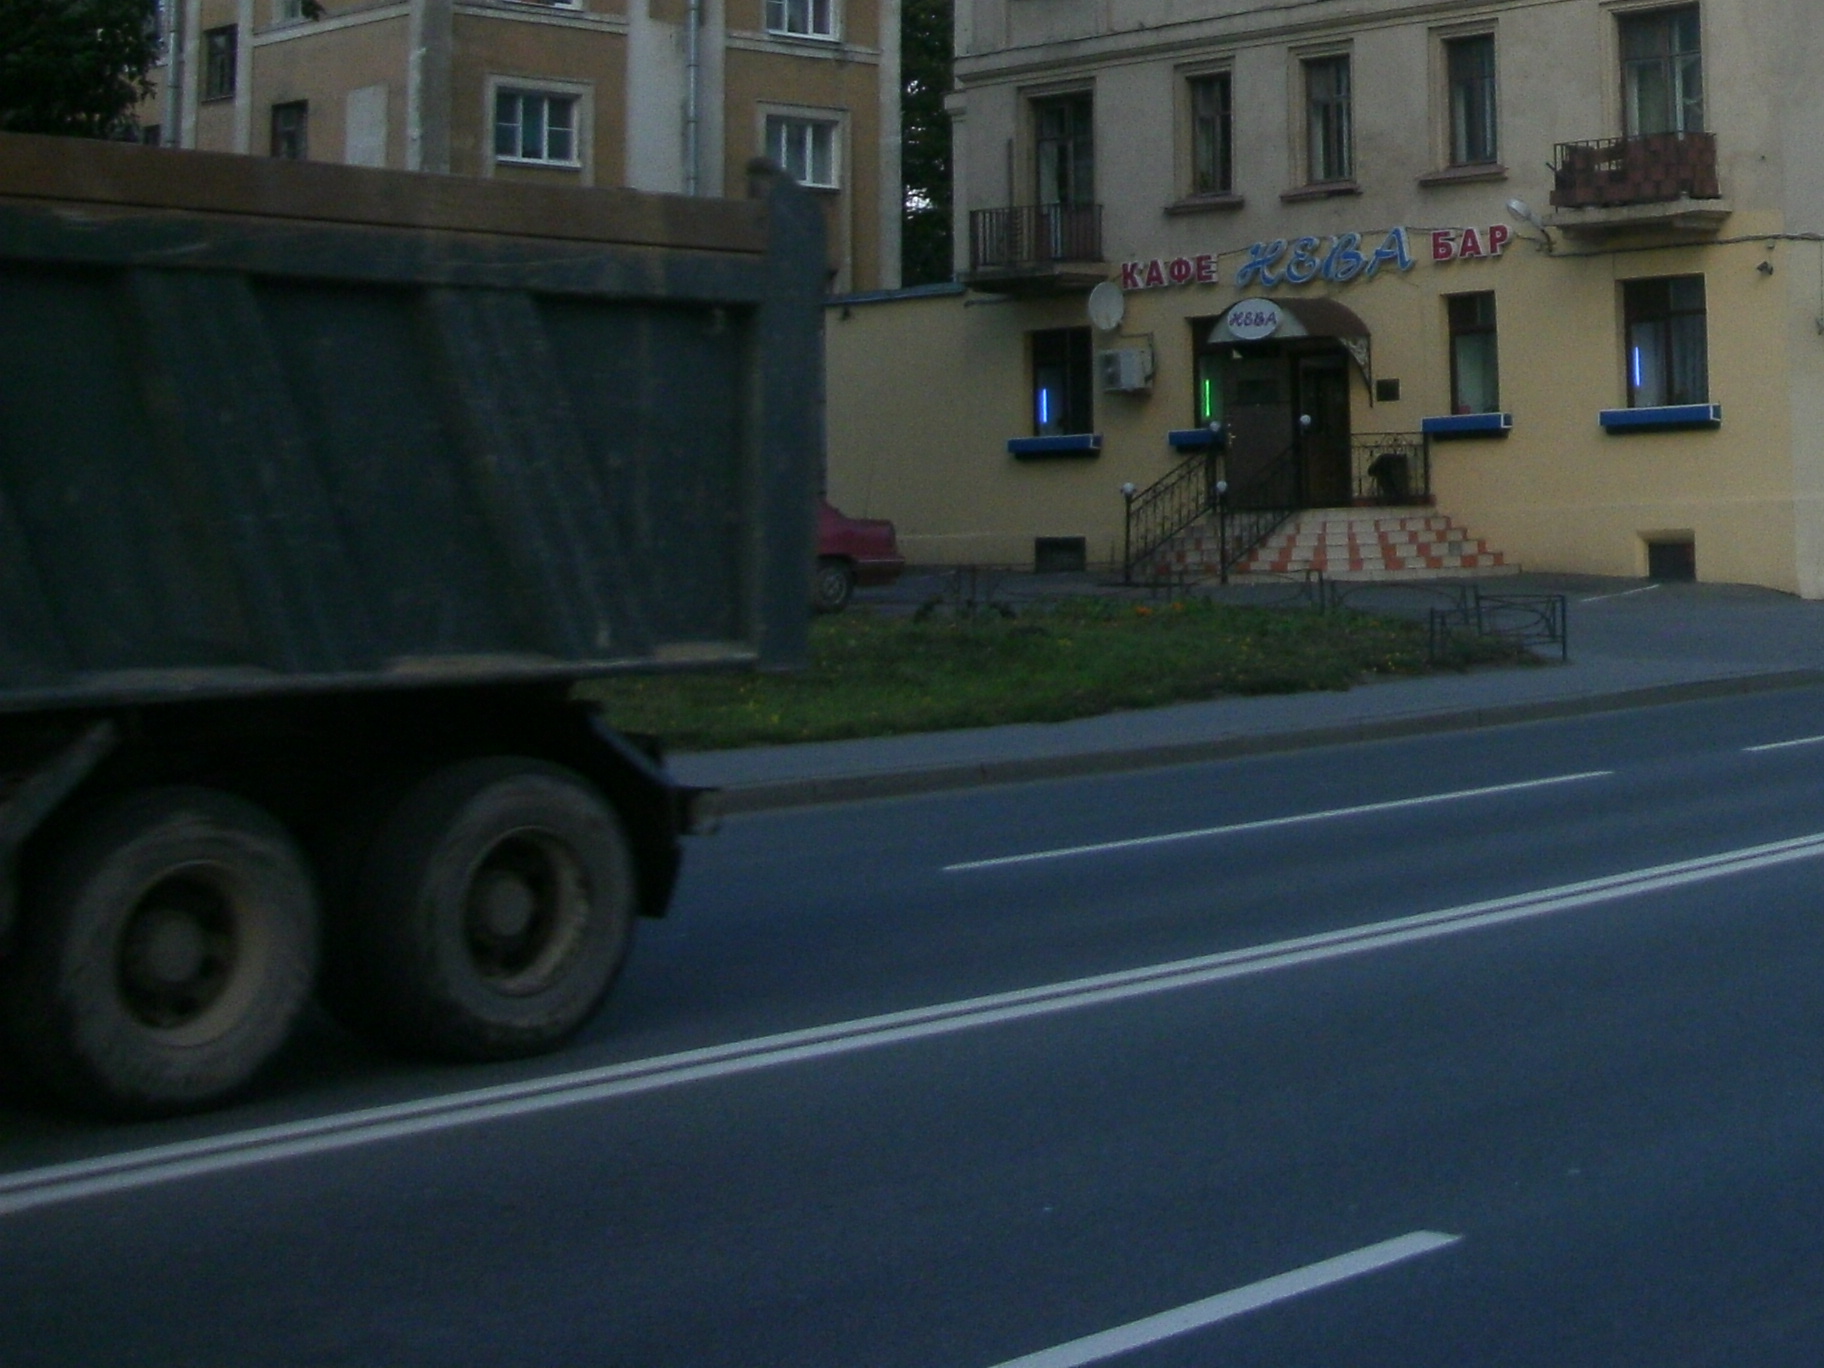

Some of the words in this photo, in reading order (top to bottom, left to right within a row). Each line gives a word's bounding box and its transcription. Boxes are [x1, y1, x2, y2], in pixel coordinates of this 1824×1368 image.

[1121, 254, 1219, 290] КАФЕ
[1235, 226, 1416, 288] НЕВА
[1431, 224, 1513, 262] БАР
[1228, 311, 1277, 327] НЕВА
